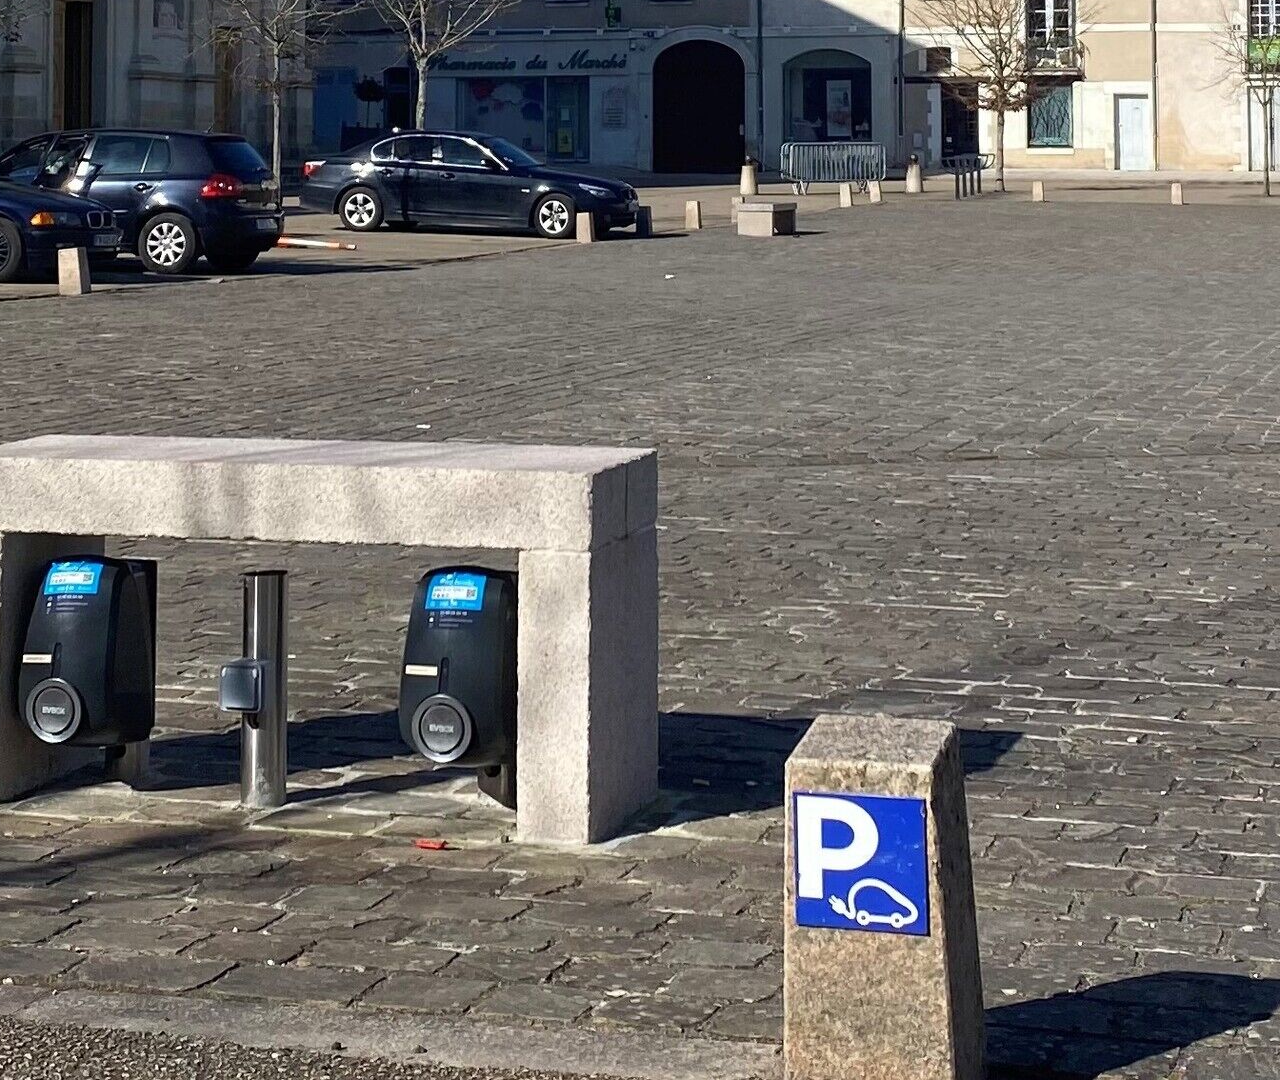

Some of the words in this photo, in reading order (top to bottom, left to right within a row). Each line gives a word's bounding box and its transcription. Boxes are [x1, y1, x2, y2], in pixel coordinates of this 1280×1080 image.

[525, 53, 547, 70] du
[557, 48, 628, 71] Marché
[41, 705, 66, 715] EVBOX
[429, 723, 454, 734] EVBOX
[796, 795, 879, 899] P
